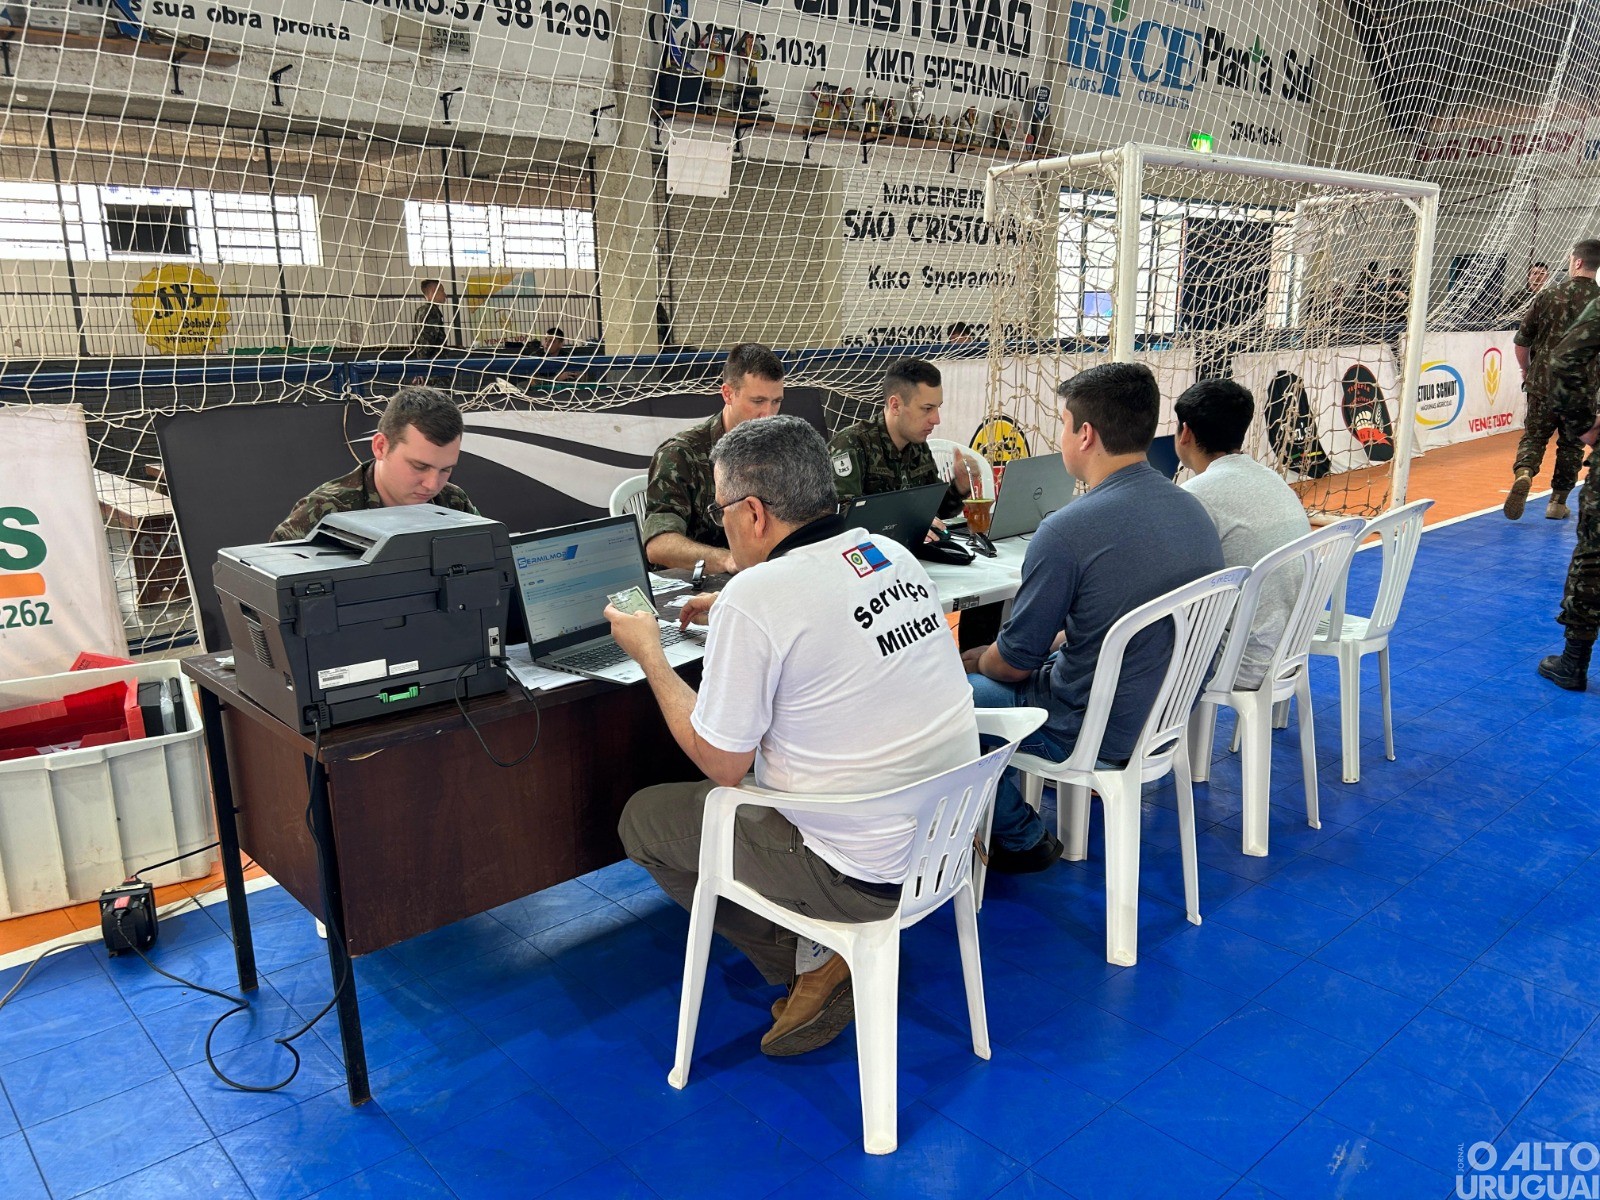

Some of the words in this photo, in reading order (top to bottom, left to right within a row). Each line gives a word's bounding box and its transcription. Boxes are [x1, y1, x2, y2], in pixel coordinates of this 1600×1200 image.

[153, 1, 196, 20] sua
[207, 6, 262, 29] obra
[273, 16, 350, 42] pronta
[540, 1, 611, 42] 1290
[866, 44, 915, 85] KIKO
[923, 56, 1031, 102] SPERANDIO
[1281, 48, 1315, 104] Sul
[1137, 89, 1190, 111] CEREALISTA
[883, 182, 986, 211] MADEIREIR
[844, 205, 896, 242] SÃO
[1468, 416, 1492, 433] VENE
[0, 600, 53, 630] 262
[854, 579, 929, 630] Serviço
[876, 612, 941, 657] Militar
